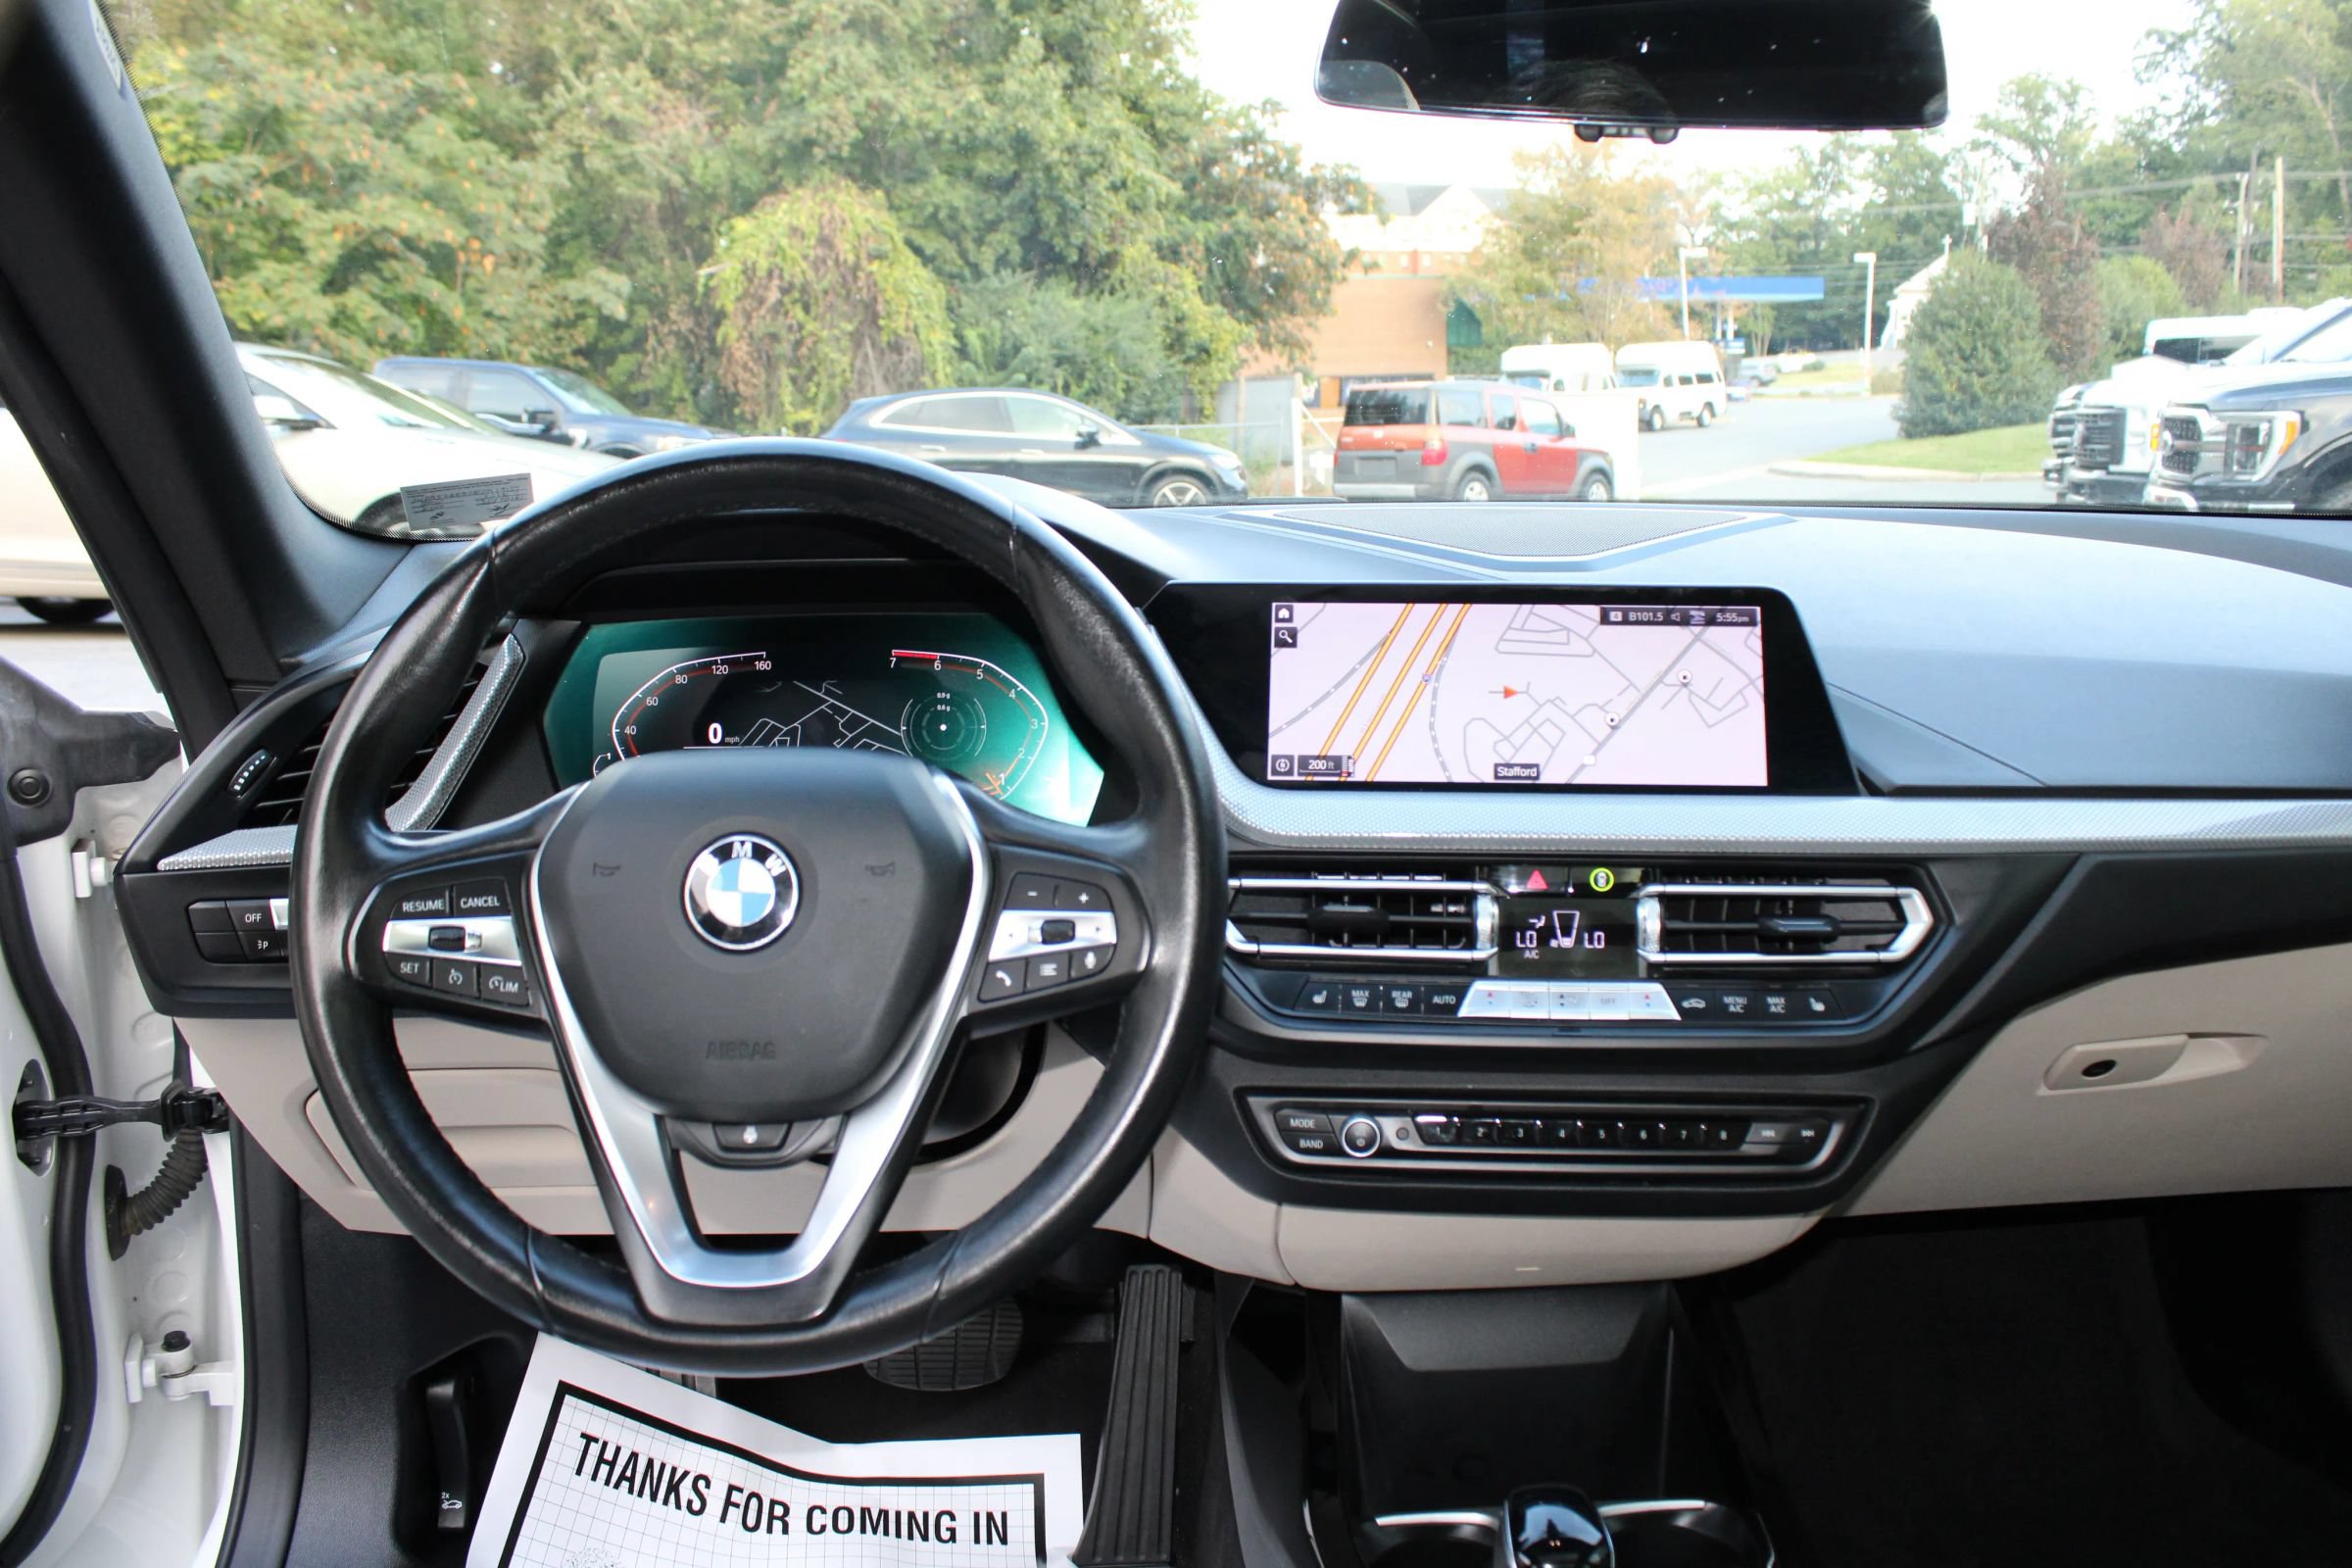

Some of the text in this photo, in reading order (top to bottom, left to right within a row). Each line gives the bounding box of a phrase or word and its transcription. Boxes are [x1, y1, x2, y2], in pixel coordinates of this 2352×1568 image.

[754, 661, 772, 670] 160
[889, 657, 897, 668] 7
[934, 660, 942, 670] 6
[711, 664, 729, 675] 120
[976, 668, 984, 680] 5
[674, 674, 688, 684] 80
[1008, 688, 1016, 700] 4
[646, 697, 659, 706] 60
[1030, 718, 1039, 729] 3
[624, 725, 637, 735] 40
[707, 722, 722, 744] 0
[1018, 748, 1025, 759] 2
[1307, 759, 1327, 770] 200
[1496, 766, 1538, 777] Stafford
[1000, 772, 1005, 785] 1
[402, 899, 445, 913] RESUME
[460, 896, 501, 909] CANCEL
[245, 912, 263, 923] OFF
[1524, 950, 1541, 959] A/C
[400, 961, 419, 974] SET
[500, 981, 518, 993] LIM
[1351, 989, 1369, 998] MAX
[1392, 990, 1412, 999] REAR
[1432, 995, 1456, 1005] AUTO
[1723, 996, 1748, 1004] MENU
[1767, 996, 1786, 1004] MAX
[1290, 1117, 1315, 1128] MODE
[1477, 1127, 1484, 1138] 2
[1517, 1128, 1524, 1138] 3
[1558, 1128, 1566, 1139] 4
[1599, 1129, 1606, 1140] 5
[1640, 1129, 1647, 1140] 6
[1681, 1130, 1688, 1140] 7
[1720, 1130, 1728, 1141] 8
[1299, 1138, 1323, 1150] BAND
[574, 1432, 1008, 1545] THANKS FOR COMING IN
[441, 1491, 450, 1499] 2x
